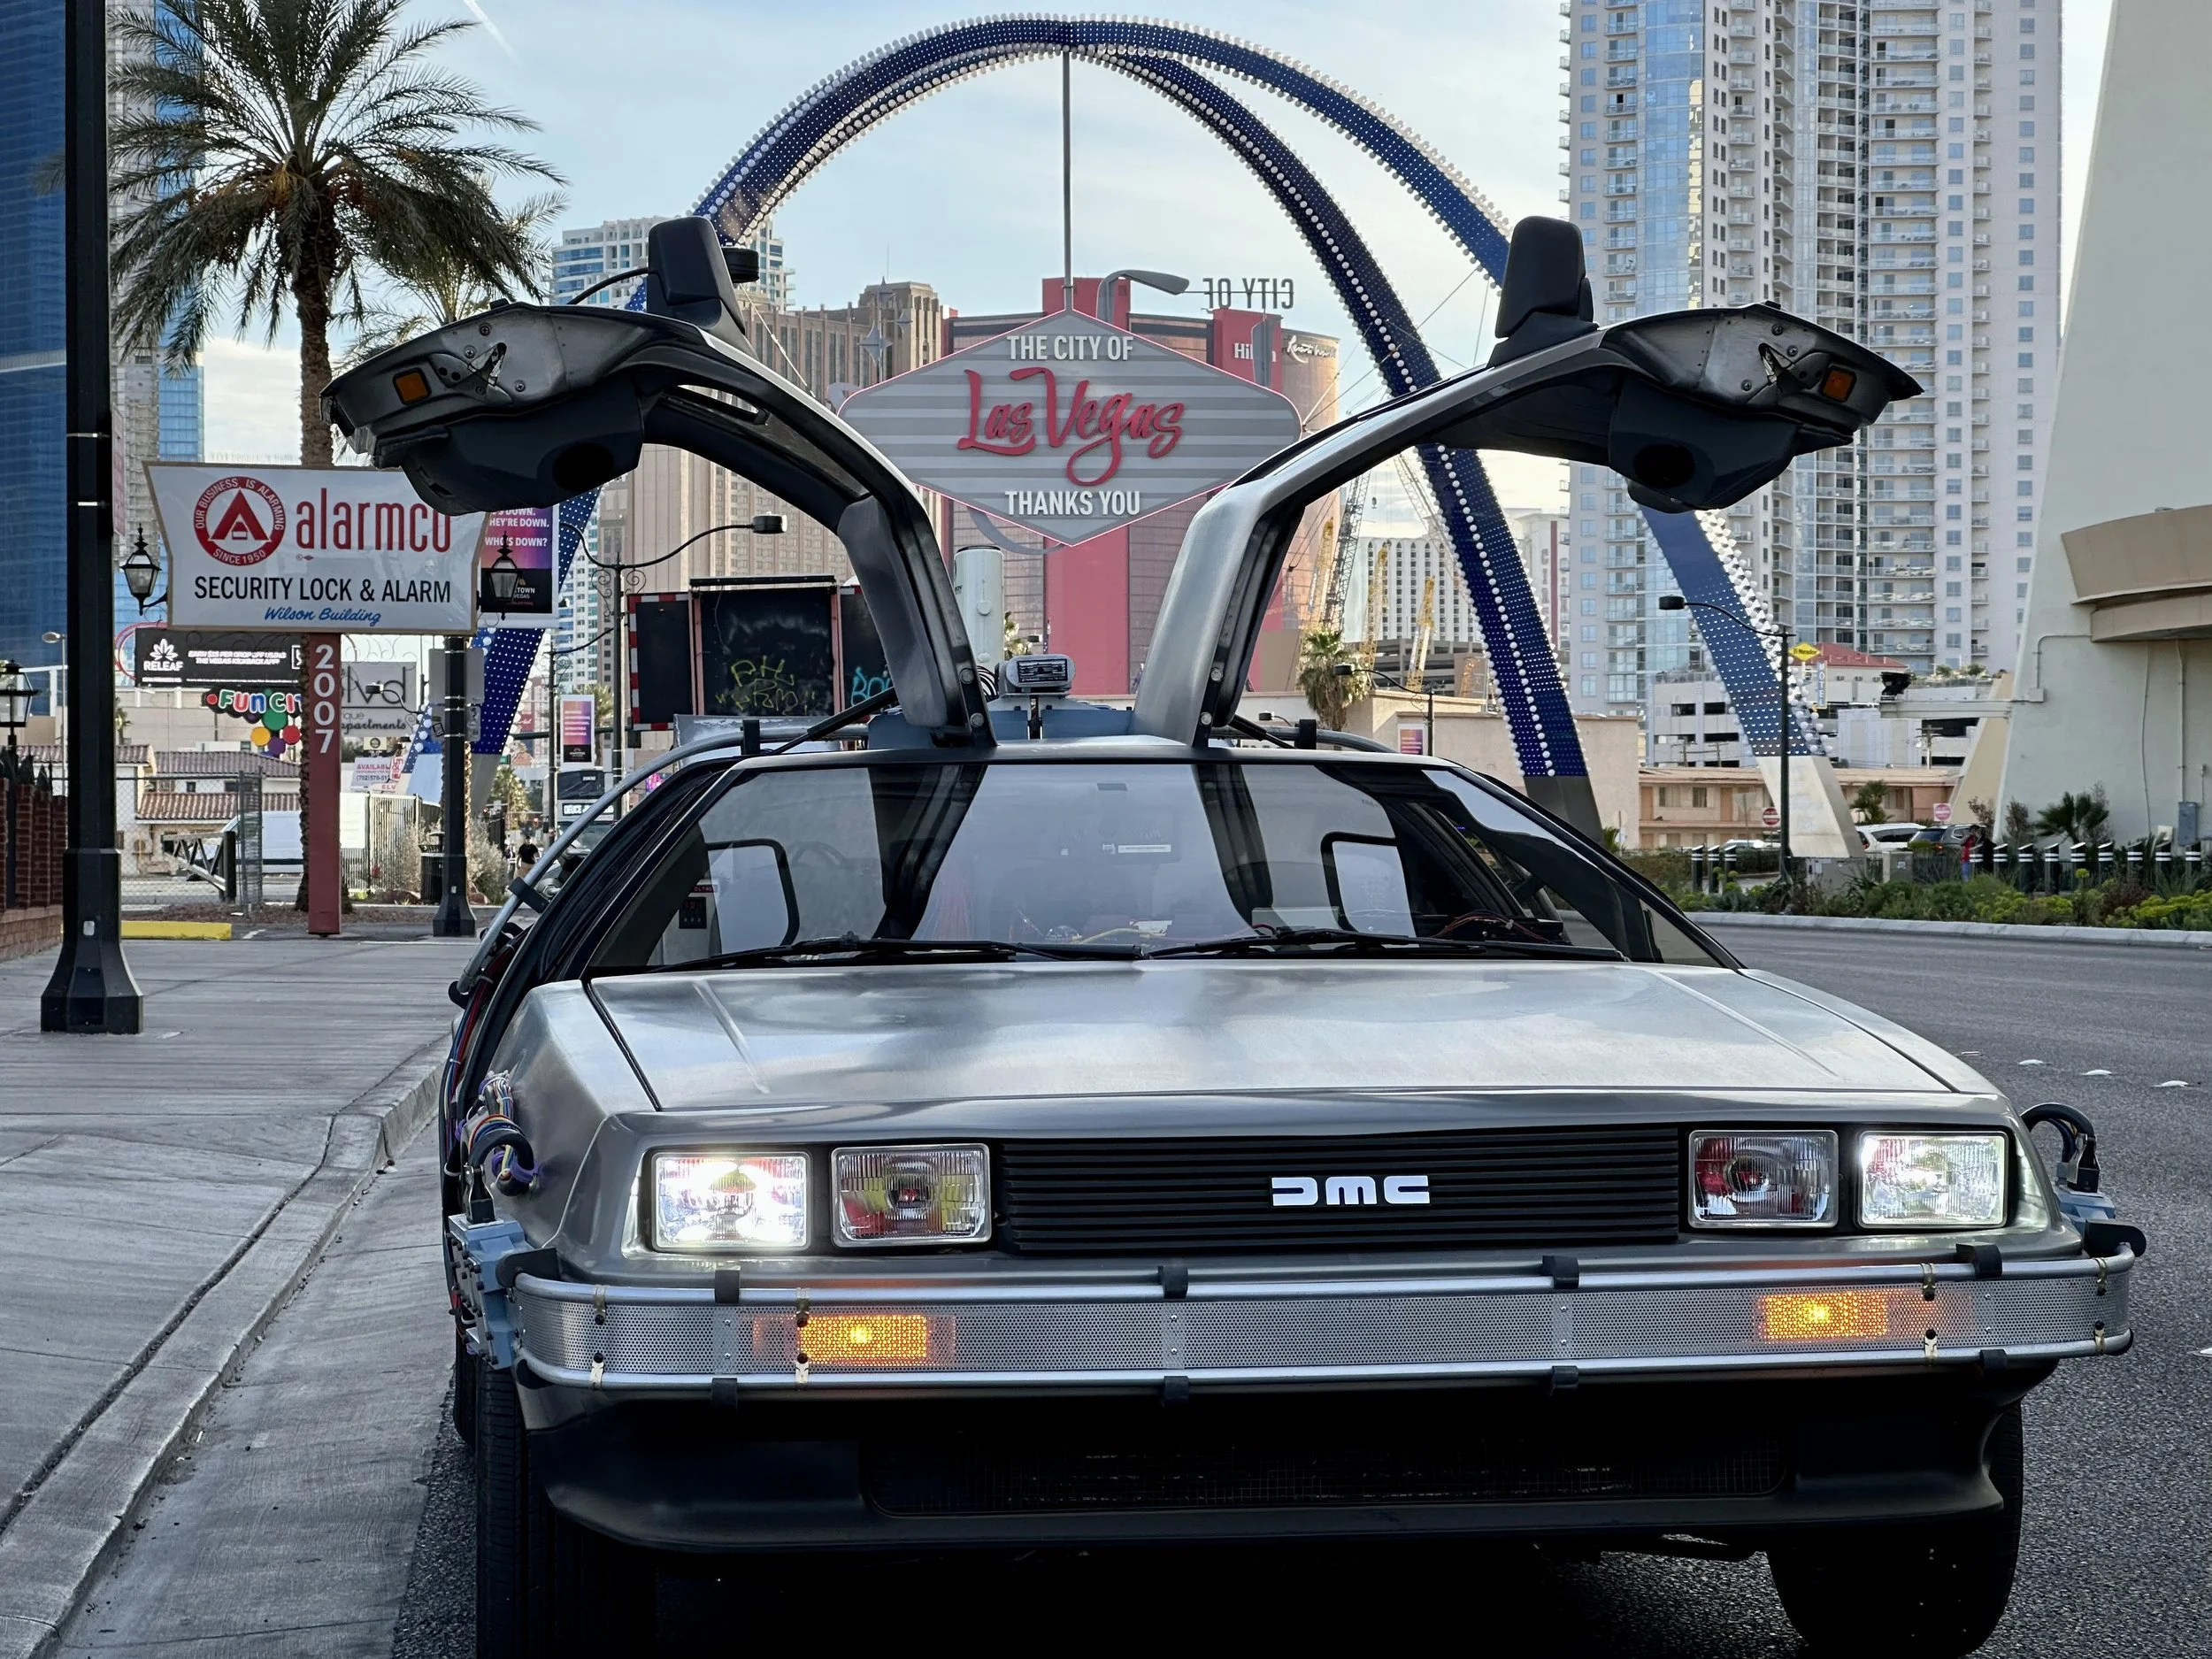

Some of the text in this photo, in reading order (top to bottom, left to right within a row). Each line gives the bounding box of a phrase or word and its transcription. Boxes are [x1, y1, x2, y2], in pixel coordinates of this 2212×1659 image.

[1007, 335, 1133, 360] THE CITY OF
[1234, 342, 1277, 363] Hiln
[956, 366, 1185, 486] Las Vegas
[195, 478, 285, 530] OUR BUSINESS IS ALARMING
[1004, 490, 1140, 516] THANKS YOU
[296, 488, 451, 553] alarmco
[489, 518, 549, 528] HEY'RE DOWN.
[515, 537, 548, 547] DOWN?
[212, 549, 266, 565] SINCE 1950
[194, 576, 451, 603] SECURITY LOCK & ALARM
[265, 607, 381, 626] Wilson Building
[143, 661, 183, 672] RELEAF
[342, 665, 406, 704] lvd
[219, 689, 265, 713] FUN
[313, 644, 335, 754] 2007
[1271, 1175, 1431, 1206] DMC
